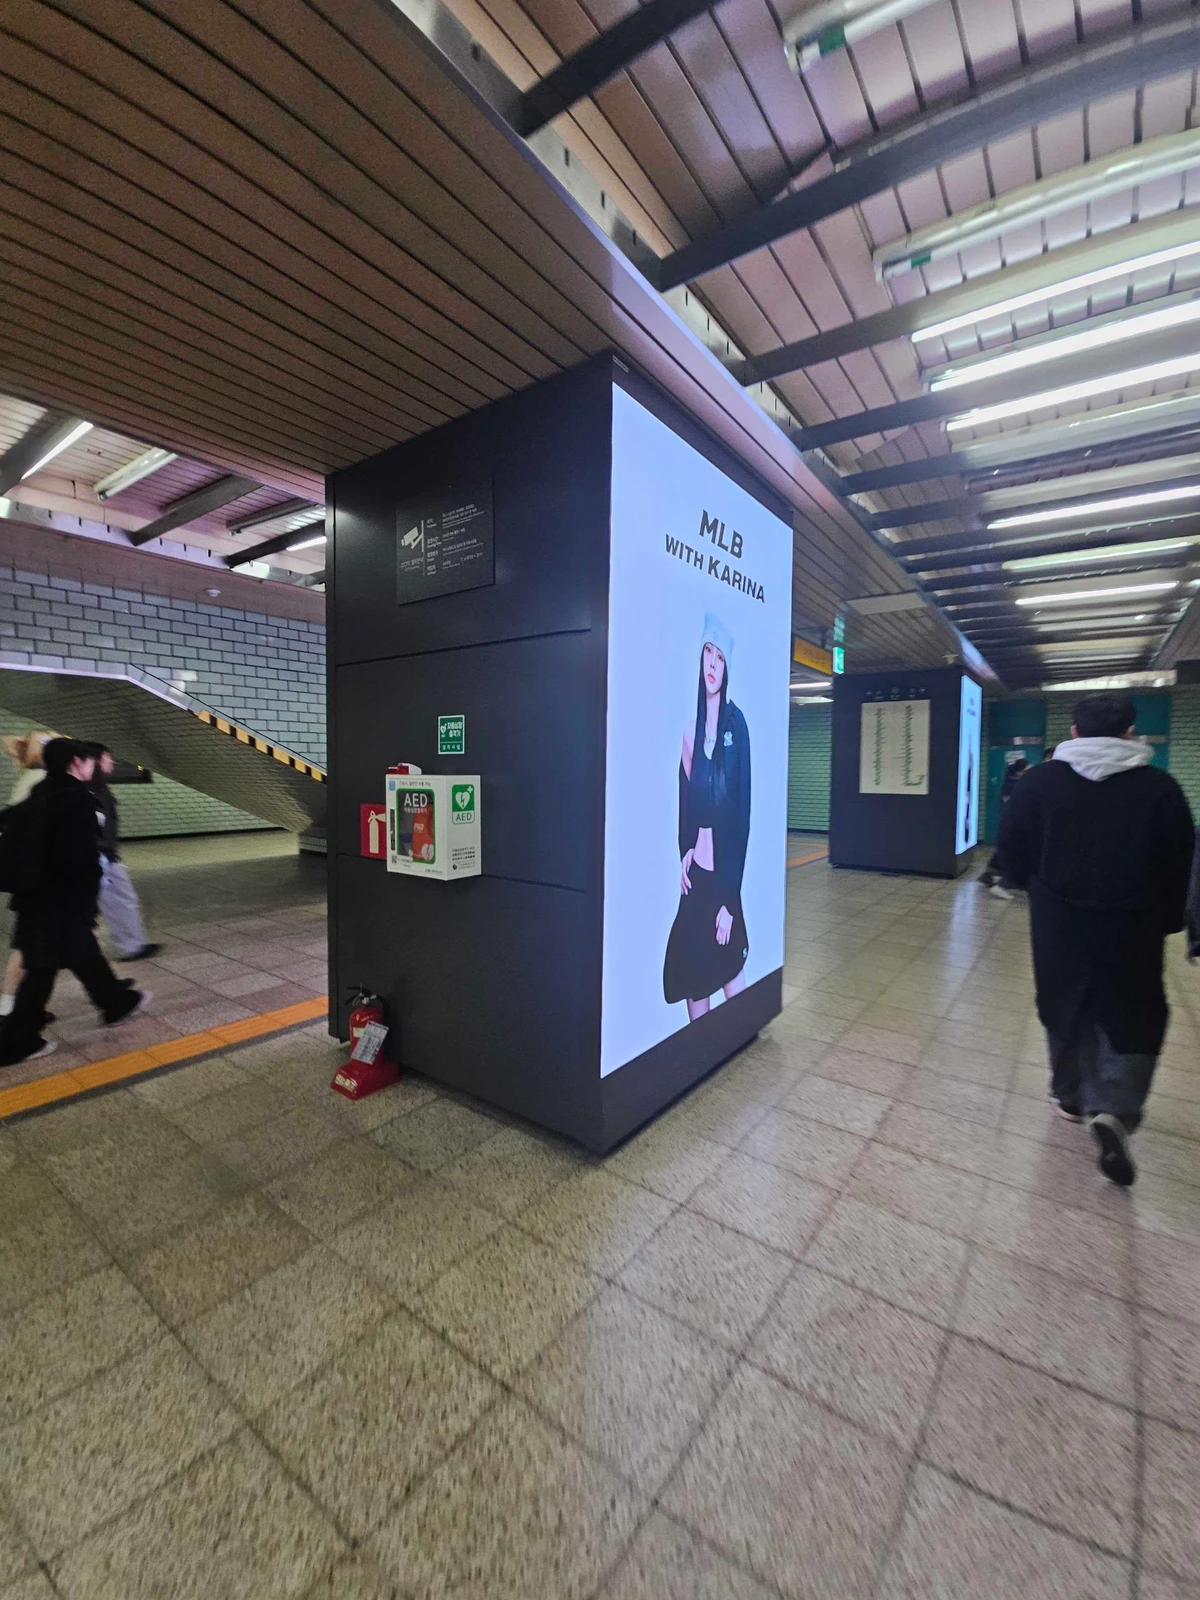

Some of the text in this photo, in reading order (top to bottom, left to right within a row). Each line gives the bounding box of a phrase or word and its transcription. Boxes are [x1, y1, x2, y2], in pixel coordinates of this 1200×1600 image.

[699, 509, 744, 559] MLB
[665, 533, 765, 604] WITH KARINA
[403, 792, 428, 808] AED
[455, 811, 472, 822] AED
